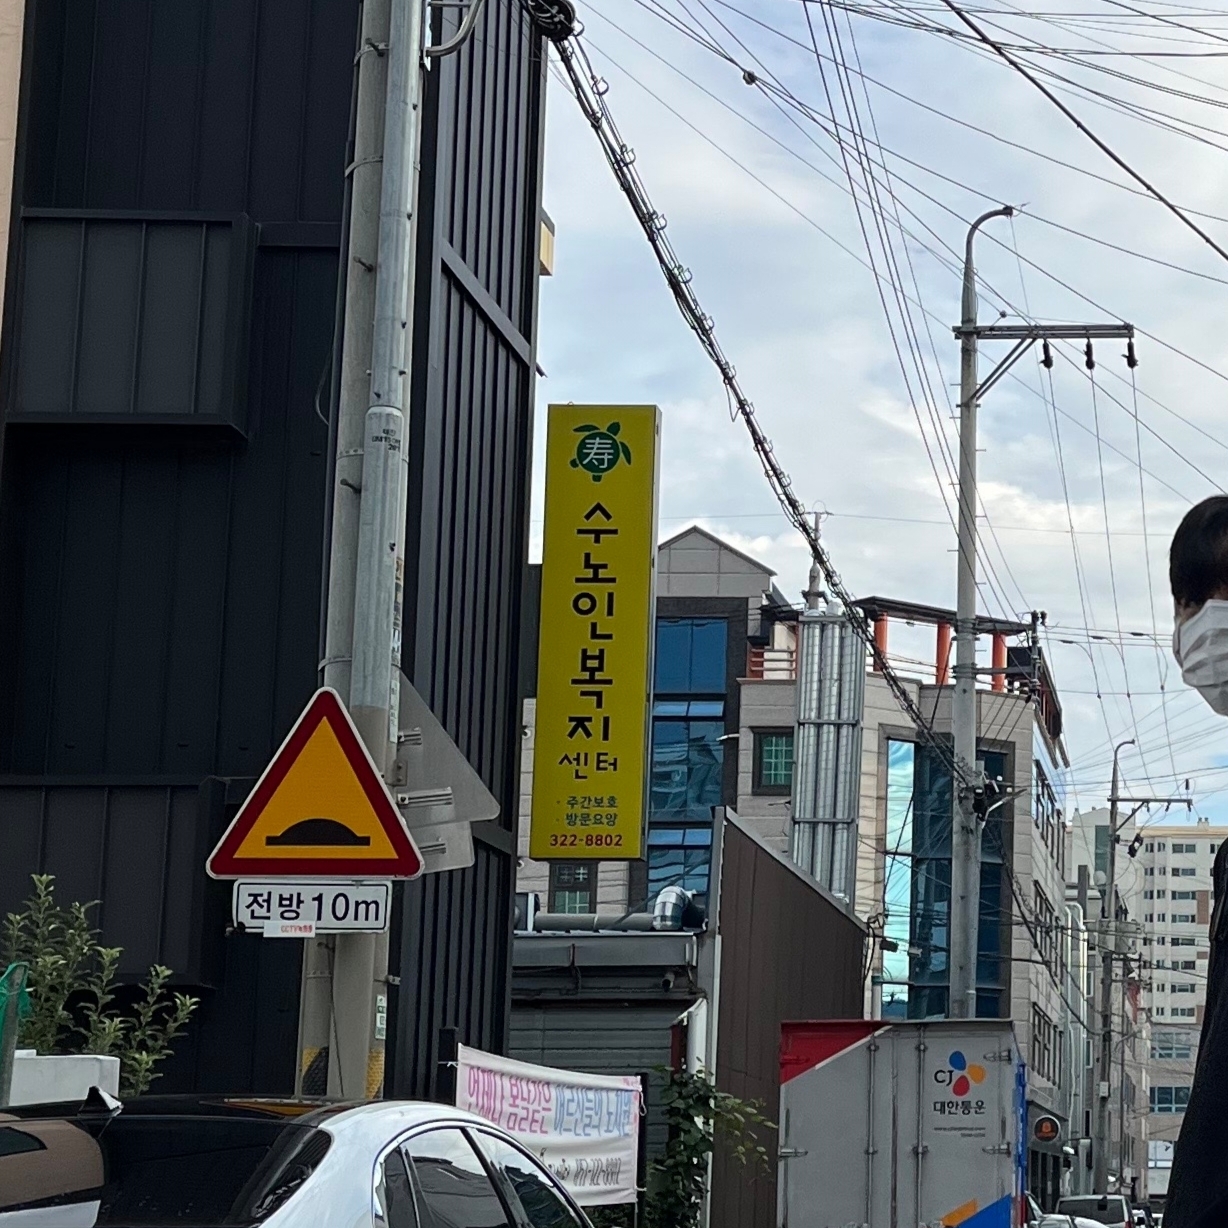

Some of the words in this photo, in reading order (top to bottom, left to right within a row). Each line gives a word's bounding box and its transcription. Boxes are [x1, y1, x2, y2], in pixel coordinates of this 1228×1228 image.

[559, 752, 618, 780] 센터
[567, 796, 617, 809] 주간보호
[566, 812, 617, 827] 방문요양
[550, 833, 623, 847] 322-8802
[934, 1069, 954, 1086] CJ
